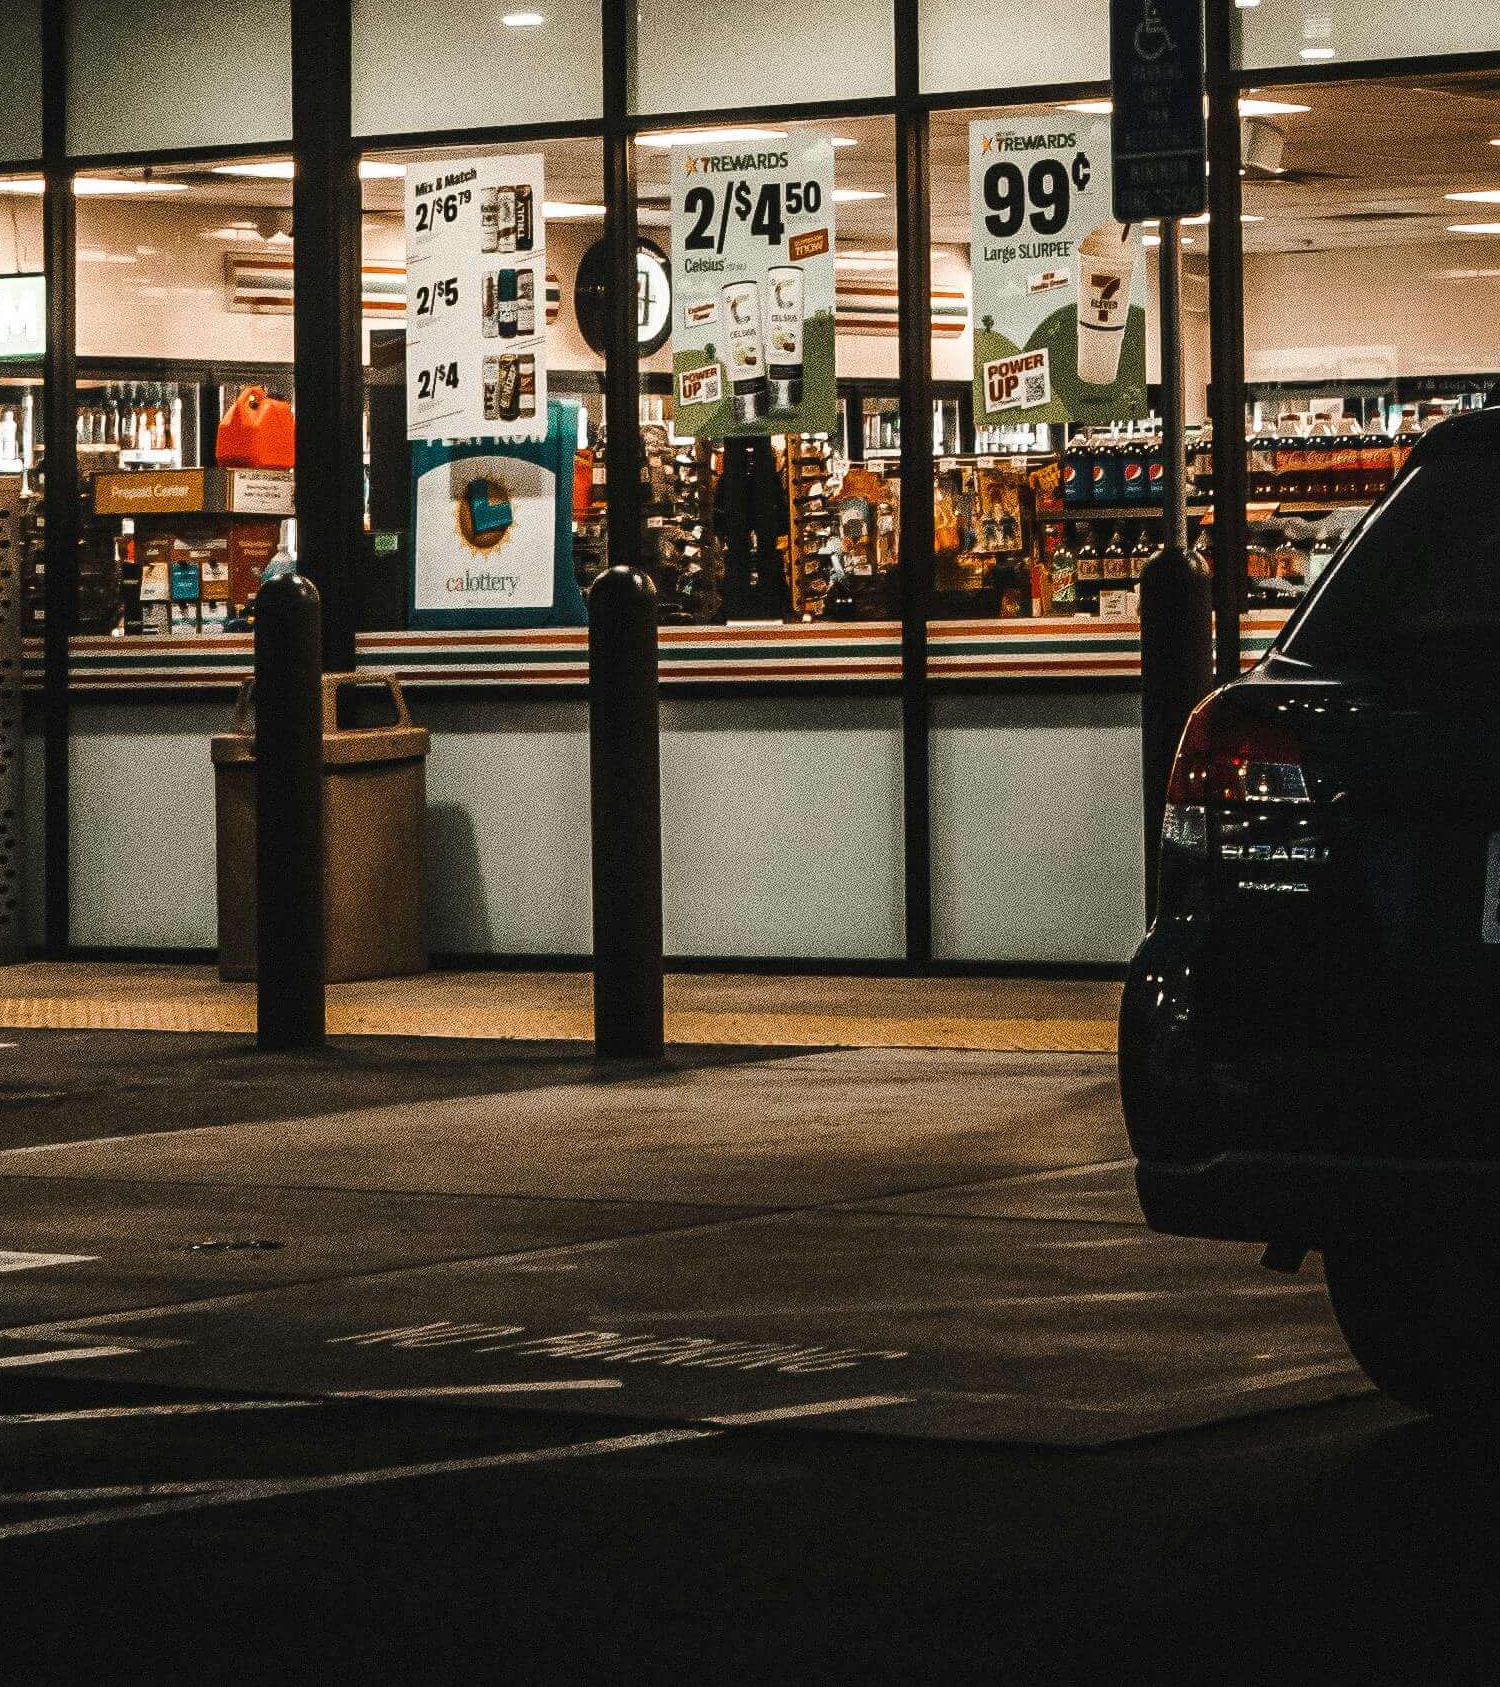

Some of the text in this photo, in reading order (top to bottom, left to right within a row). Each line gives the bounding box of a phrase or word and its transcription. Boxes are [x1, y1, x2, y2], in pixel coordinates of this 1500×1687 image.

[996, 132, 1076, 152] 7REWARDS
[700, 151, 789, 173] 7REWARDS
[415, 182, 433, 197] Mix
[444, 167, 477, 189] Match
[984, 151, 1091, 238] 99¢
[984, 245, 1016, 264] Large
[416, 277, 459, 316] 2/$5
[1091, 274, 1121, 322] 7
[417, 361, 460, 399] 2/$4
[682, 367, 718, 382] POWER
[987, 353, 1044, 380] POWER
[682, 382, 702, 399] UP
[988, 376, 1018, 403] UP
